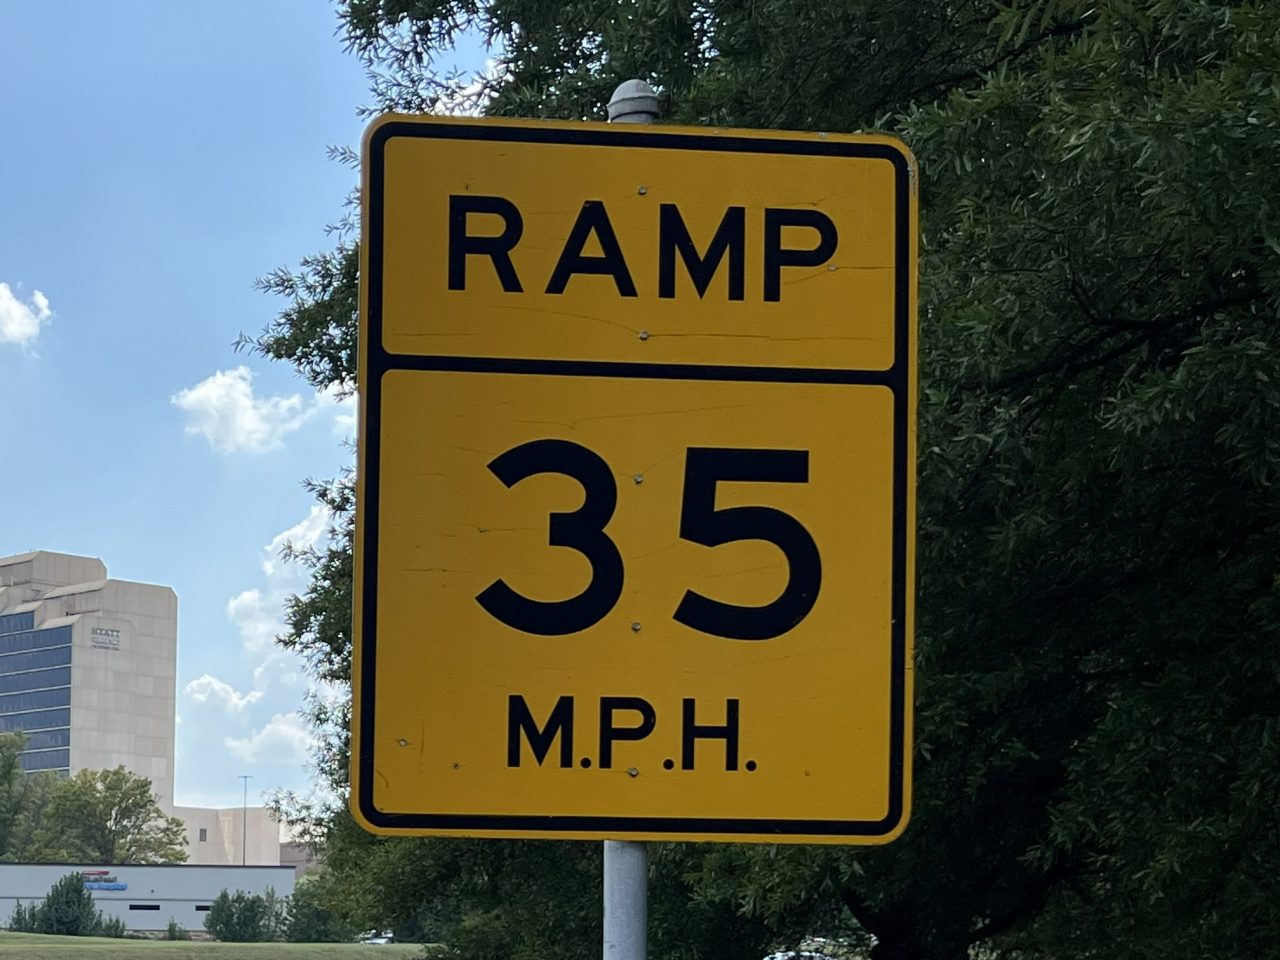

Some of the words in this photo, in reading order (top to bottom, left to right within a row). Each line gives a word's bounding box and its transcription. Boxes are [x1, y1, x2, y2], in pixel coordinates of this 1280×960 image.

[447, 194, 839, 303] RAMP
[474, 438, 822, 641] 35
[507, 694, 757, 772] M.P.H.
